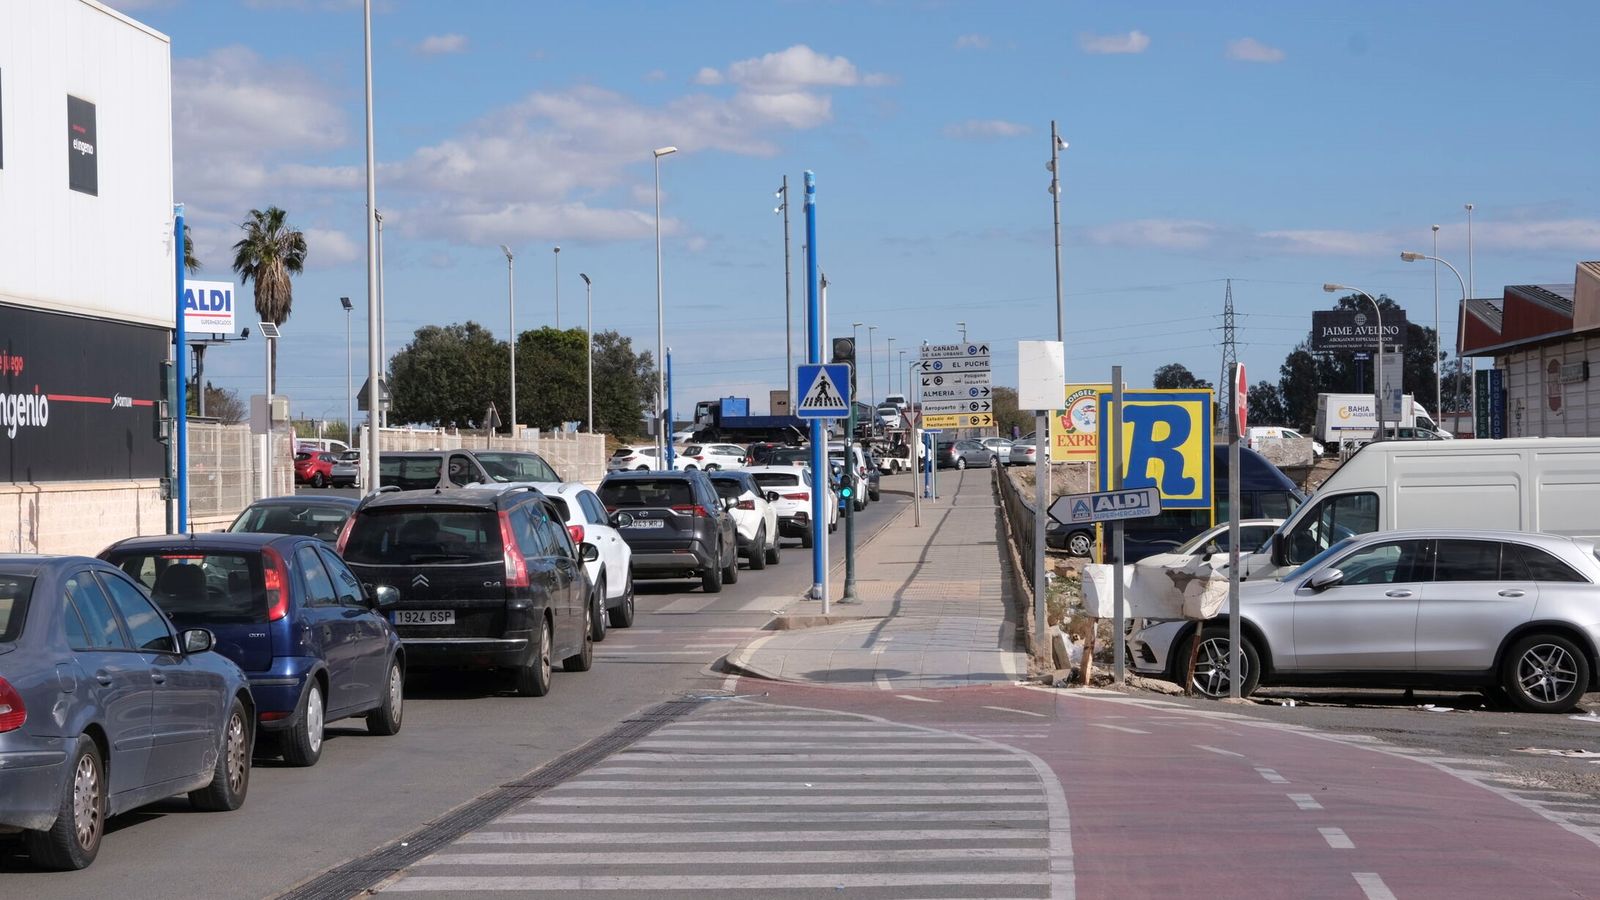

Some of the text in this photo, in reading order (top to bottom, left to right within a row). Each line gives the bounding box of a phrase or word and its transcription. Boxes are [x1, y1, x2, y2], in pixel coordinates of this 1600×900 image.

[184, 289, 231, 311] ALDI
[1322, 326, 1352, 337] JAIME
[1056, 434, 1096, 447] EXPR
[1122, 404, 1196, 496] R
[1095, 492, 1149, 511] ALDI
[1094, 508, 1151, 520] SUPERMERCADOS
[399, 611, 452, 623] 1924 GSP
